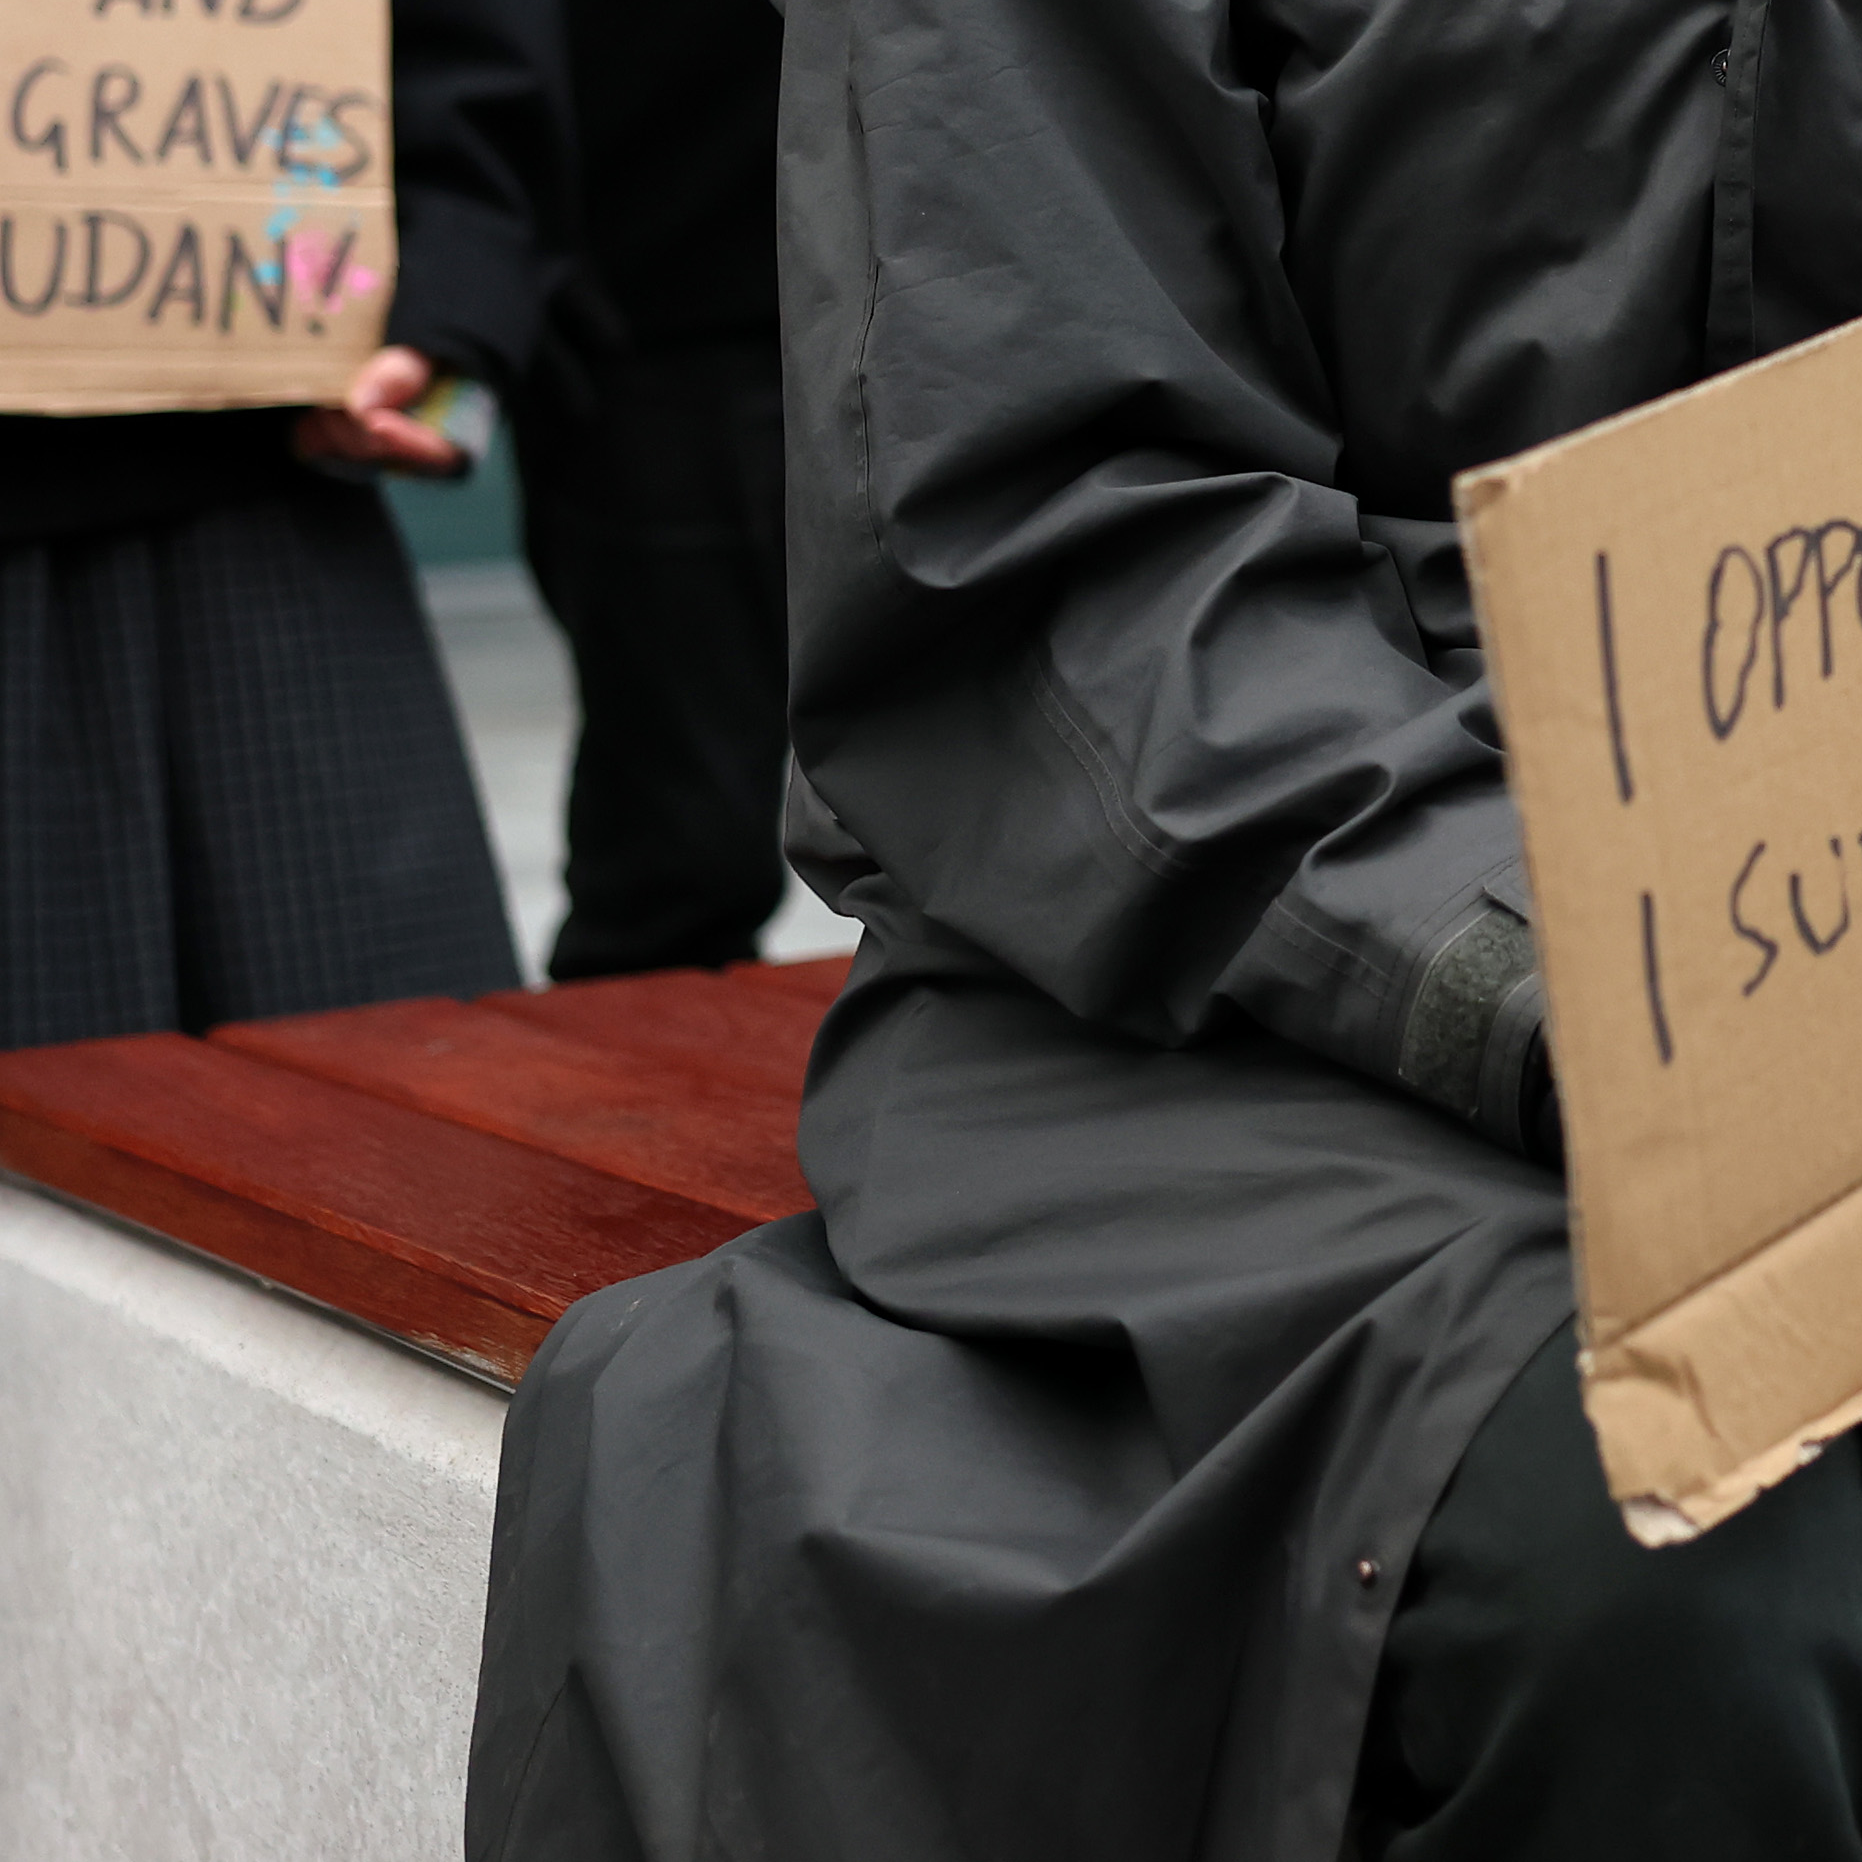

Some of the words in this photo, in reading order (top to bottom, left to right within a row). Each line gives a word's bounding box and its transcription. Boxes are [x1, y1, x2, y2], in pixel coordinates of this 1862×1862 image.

[10, 56, 378, 181] GRAVES
[0, 209, 358, 337] UDAN!
[1595, 550, 1634, 804] I
[1640, 891, 1674, 1066] I
